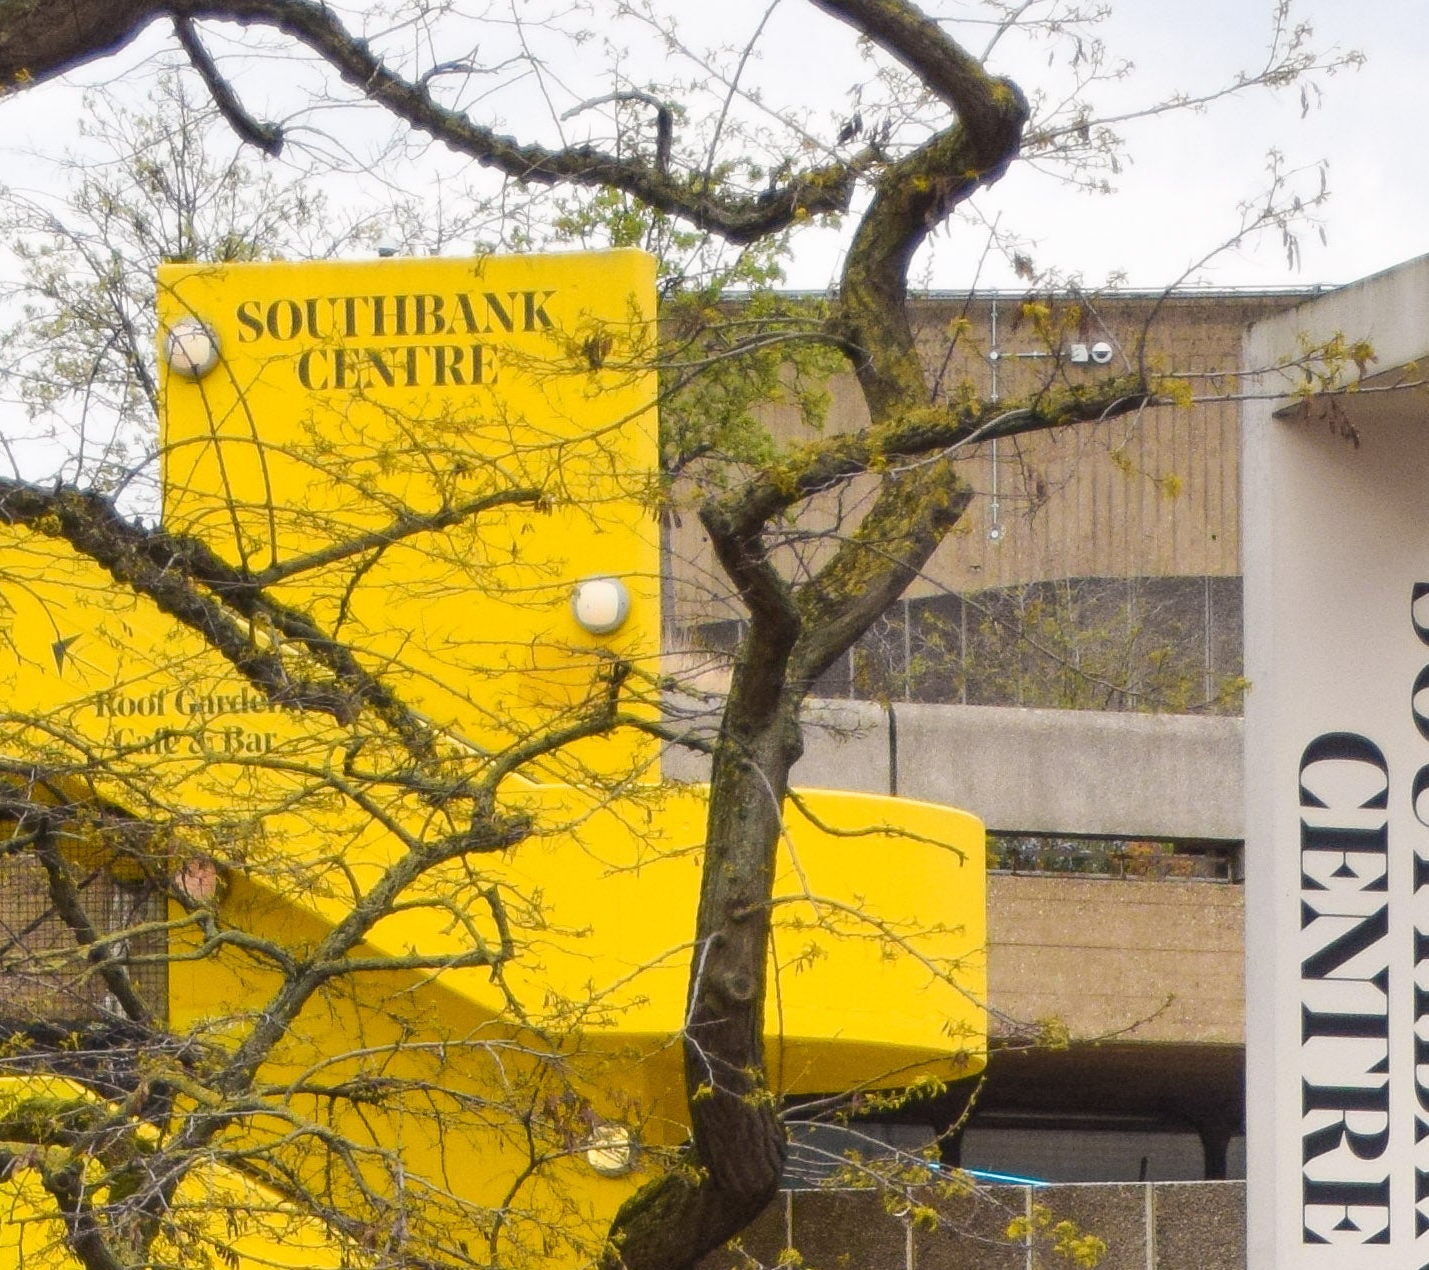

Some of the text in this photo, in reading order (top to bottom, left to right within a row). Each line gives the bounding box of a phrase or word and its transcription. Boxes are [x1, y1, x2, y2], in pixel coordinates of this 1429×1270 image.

[236, 289, 558, 343] SOUTHBANK
[298, 344, 499, 391] CENTRE
[95, 689, 168, 718] Roof
[223, 726, 277, 754] Bar
[1299, 731, 1391, 1246] CENTRE
